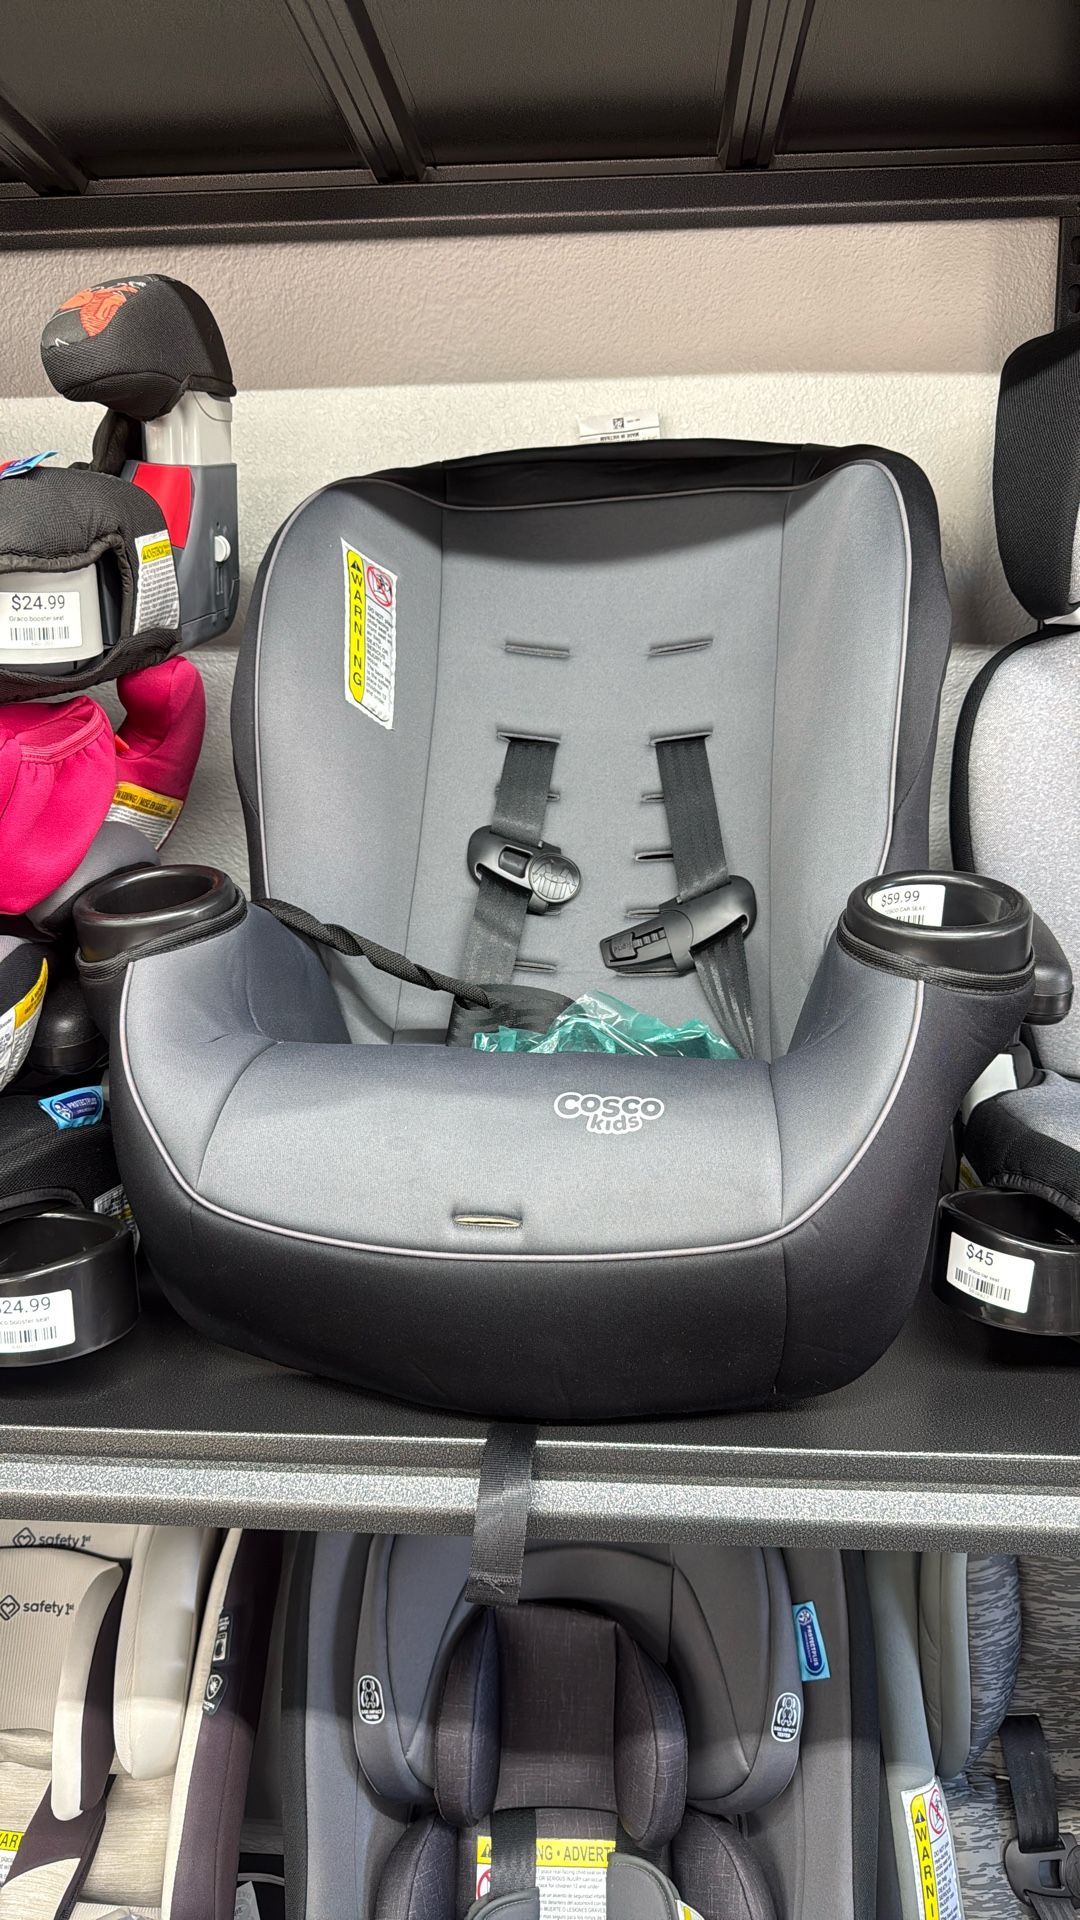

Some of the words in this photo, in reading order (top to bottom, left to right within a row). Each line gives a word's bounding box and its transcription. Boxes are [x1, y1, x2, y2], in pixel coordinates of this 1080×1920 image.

[11, 593, 65, 612] $24.99
[350, 571, 362, 687] WARNING
[881, 890, 920, 908] $59.99
[588, 1114, 641, 1132] kids
[966, 1243, 994, 1266] $45
[0, 1296, 50, 1314] 24.99
[23, 1600, 64, 1617] safety
[916, 1826, 935, 1918] WARNI
